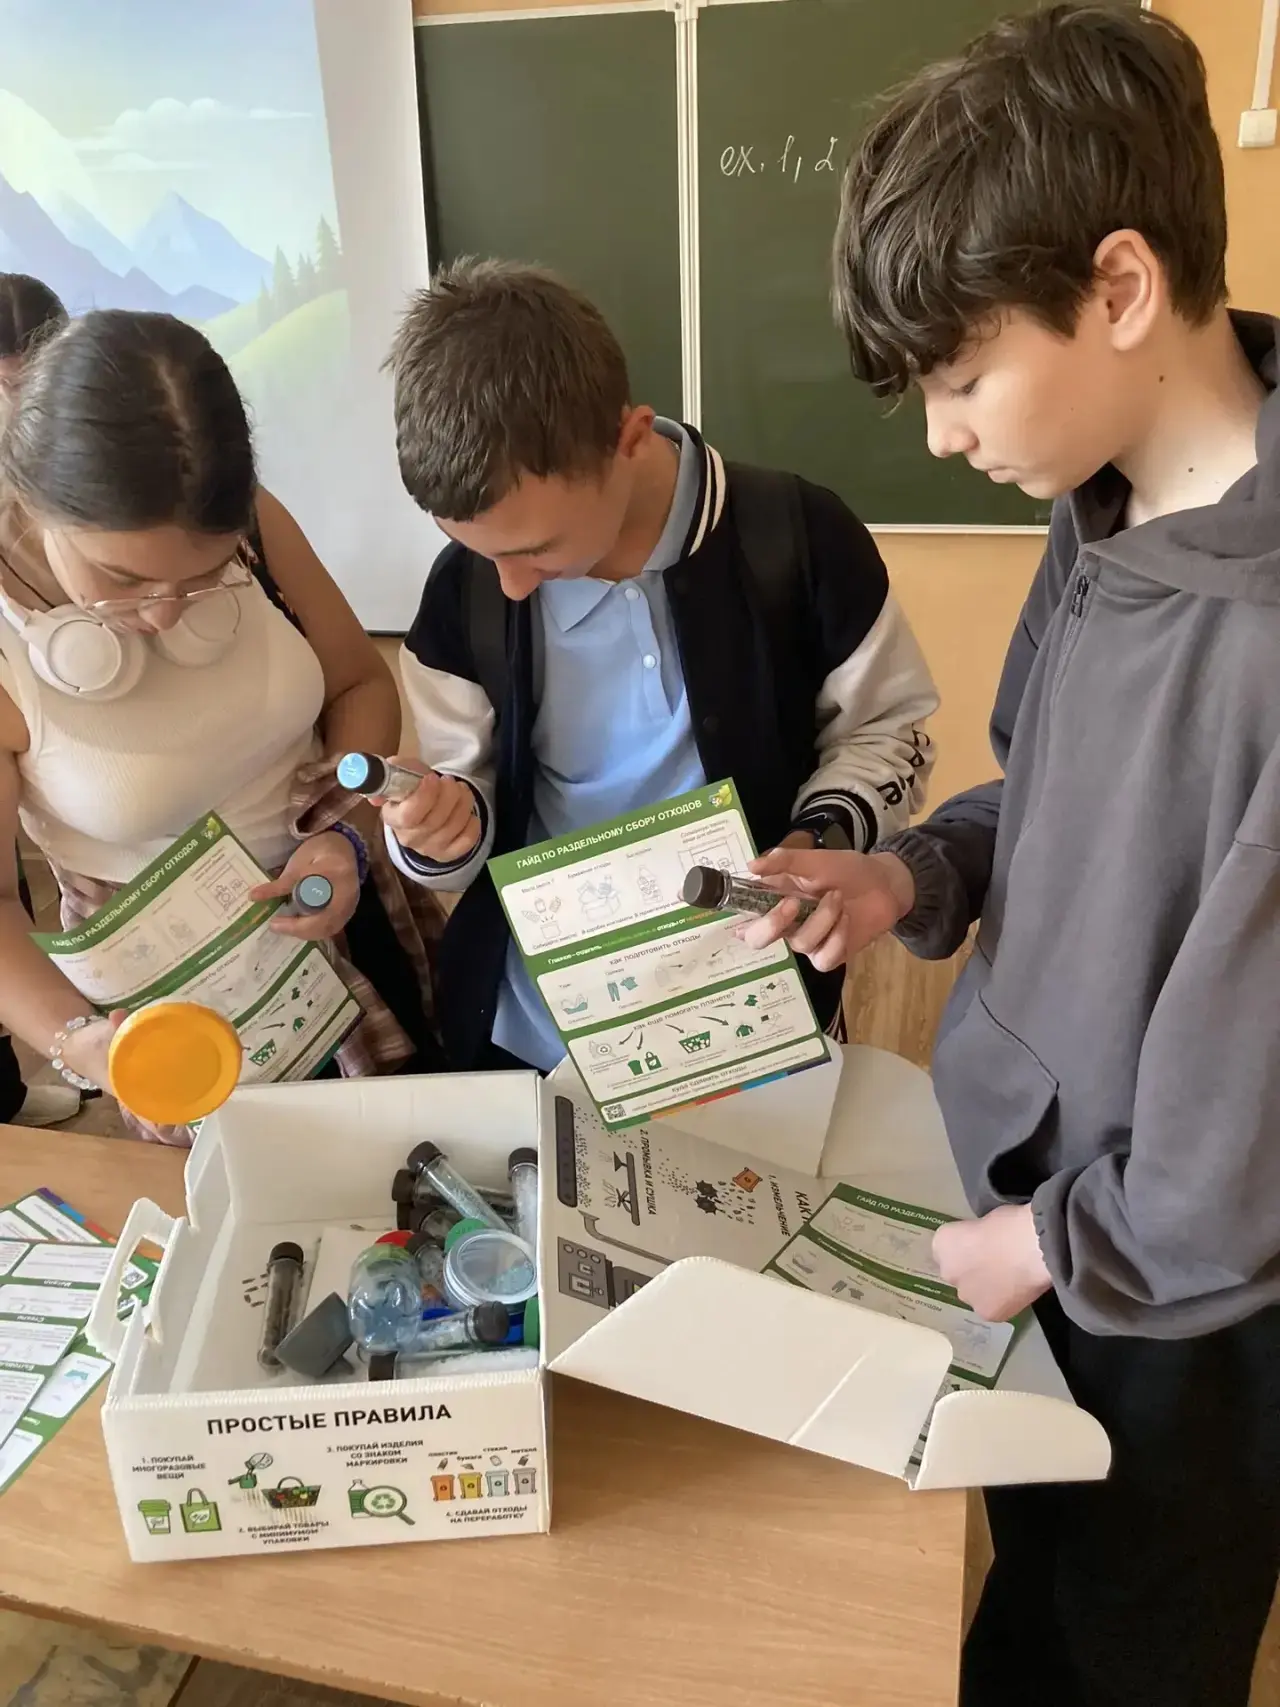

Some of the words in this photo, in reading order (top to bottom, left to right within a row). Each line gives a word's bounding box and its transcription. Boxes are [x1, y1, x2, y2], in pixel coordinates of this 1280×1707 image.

[516, 853, 542, 869] ГАЙД
[542, 850, 556, 861] ПО
[556, 825, 624, 856] РАЗДЕЛЬНОМУ
[625, 815, 657, 833] СБОРУ
[657, 799, 703, 822] ОТХОДОВ
[72, 934, 87, 943] ПО
[86, 888, 142, 937] РАЗДЕЛЬНОМУ
[140, 867, 166, 892] СБОРУ
[164, 838, 200, 871] ОТХОДОВ
[672, 933, 702, 946] отходы
[795, 1191, 812, 1215] КАК
[856, 1194, 877, 1206] ГАЙД
[878, 1202, 890, 1210] ПО
[769, 1180, 791, 1237] ИЗМЕЛЬЧЕНИЕ
[207, 1412, 327, 1435] ПРОСТЫЕ
[334, 1404, 452, 1427] ПРАВИЛА
[336, 1442, 379, 1452] ПОКУПАЙ
[381, 1440, 424, 1449] ИЗДЕЛИЯ
[151, 1454, 194, 1464] ПОКУПАЙ
[364, 1450, 401, 1458] ЗНАКОМ
[132, 1462, 206, 1472] МНОГОРАЗОВЫЕ
[346, 1458, 408, 1467] МАРКИРОВКИ
[156, 1472, 185, 1480] ВЕЩИ
[455, 1507, 490, 1517] СДАВАЙ
[492, 1505, 528, 1514] ОТХОДЫ
[464, 1512, 525, 1523] ПЕРЕРАБОТКУ
[247, 1522, 291, 1532] ВЫБИРАЙ
[293, 1521, 329, 1529] ТОВАРЫ
[259, 1529, 319, 1538] МИНИМУМОМ
[263, 1536, 310, 1545] УПАКОВКИ
